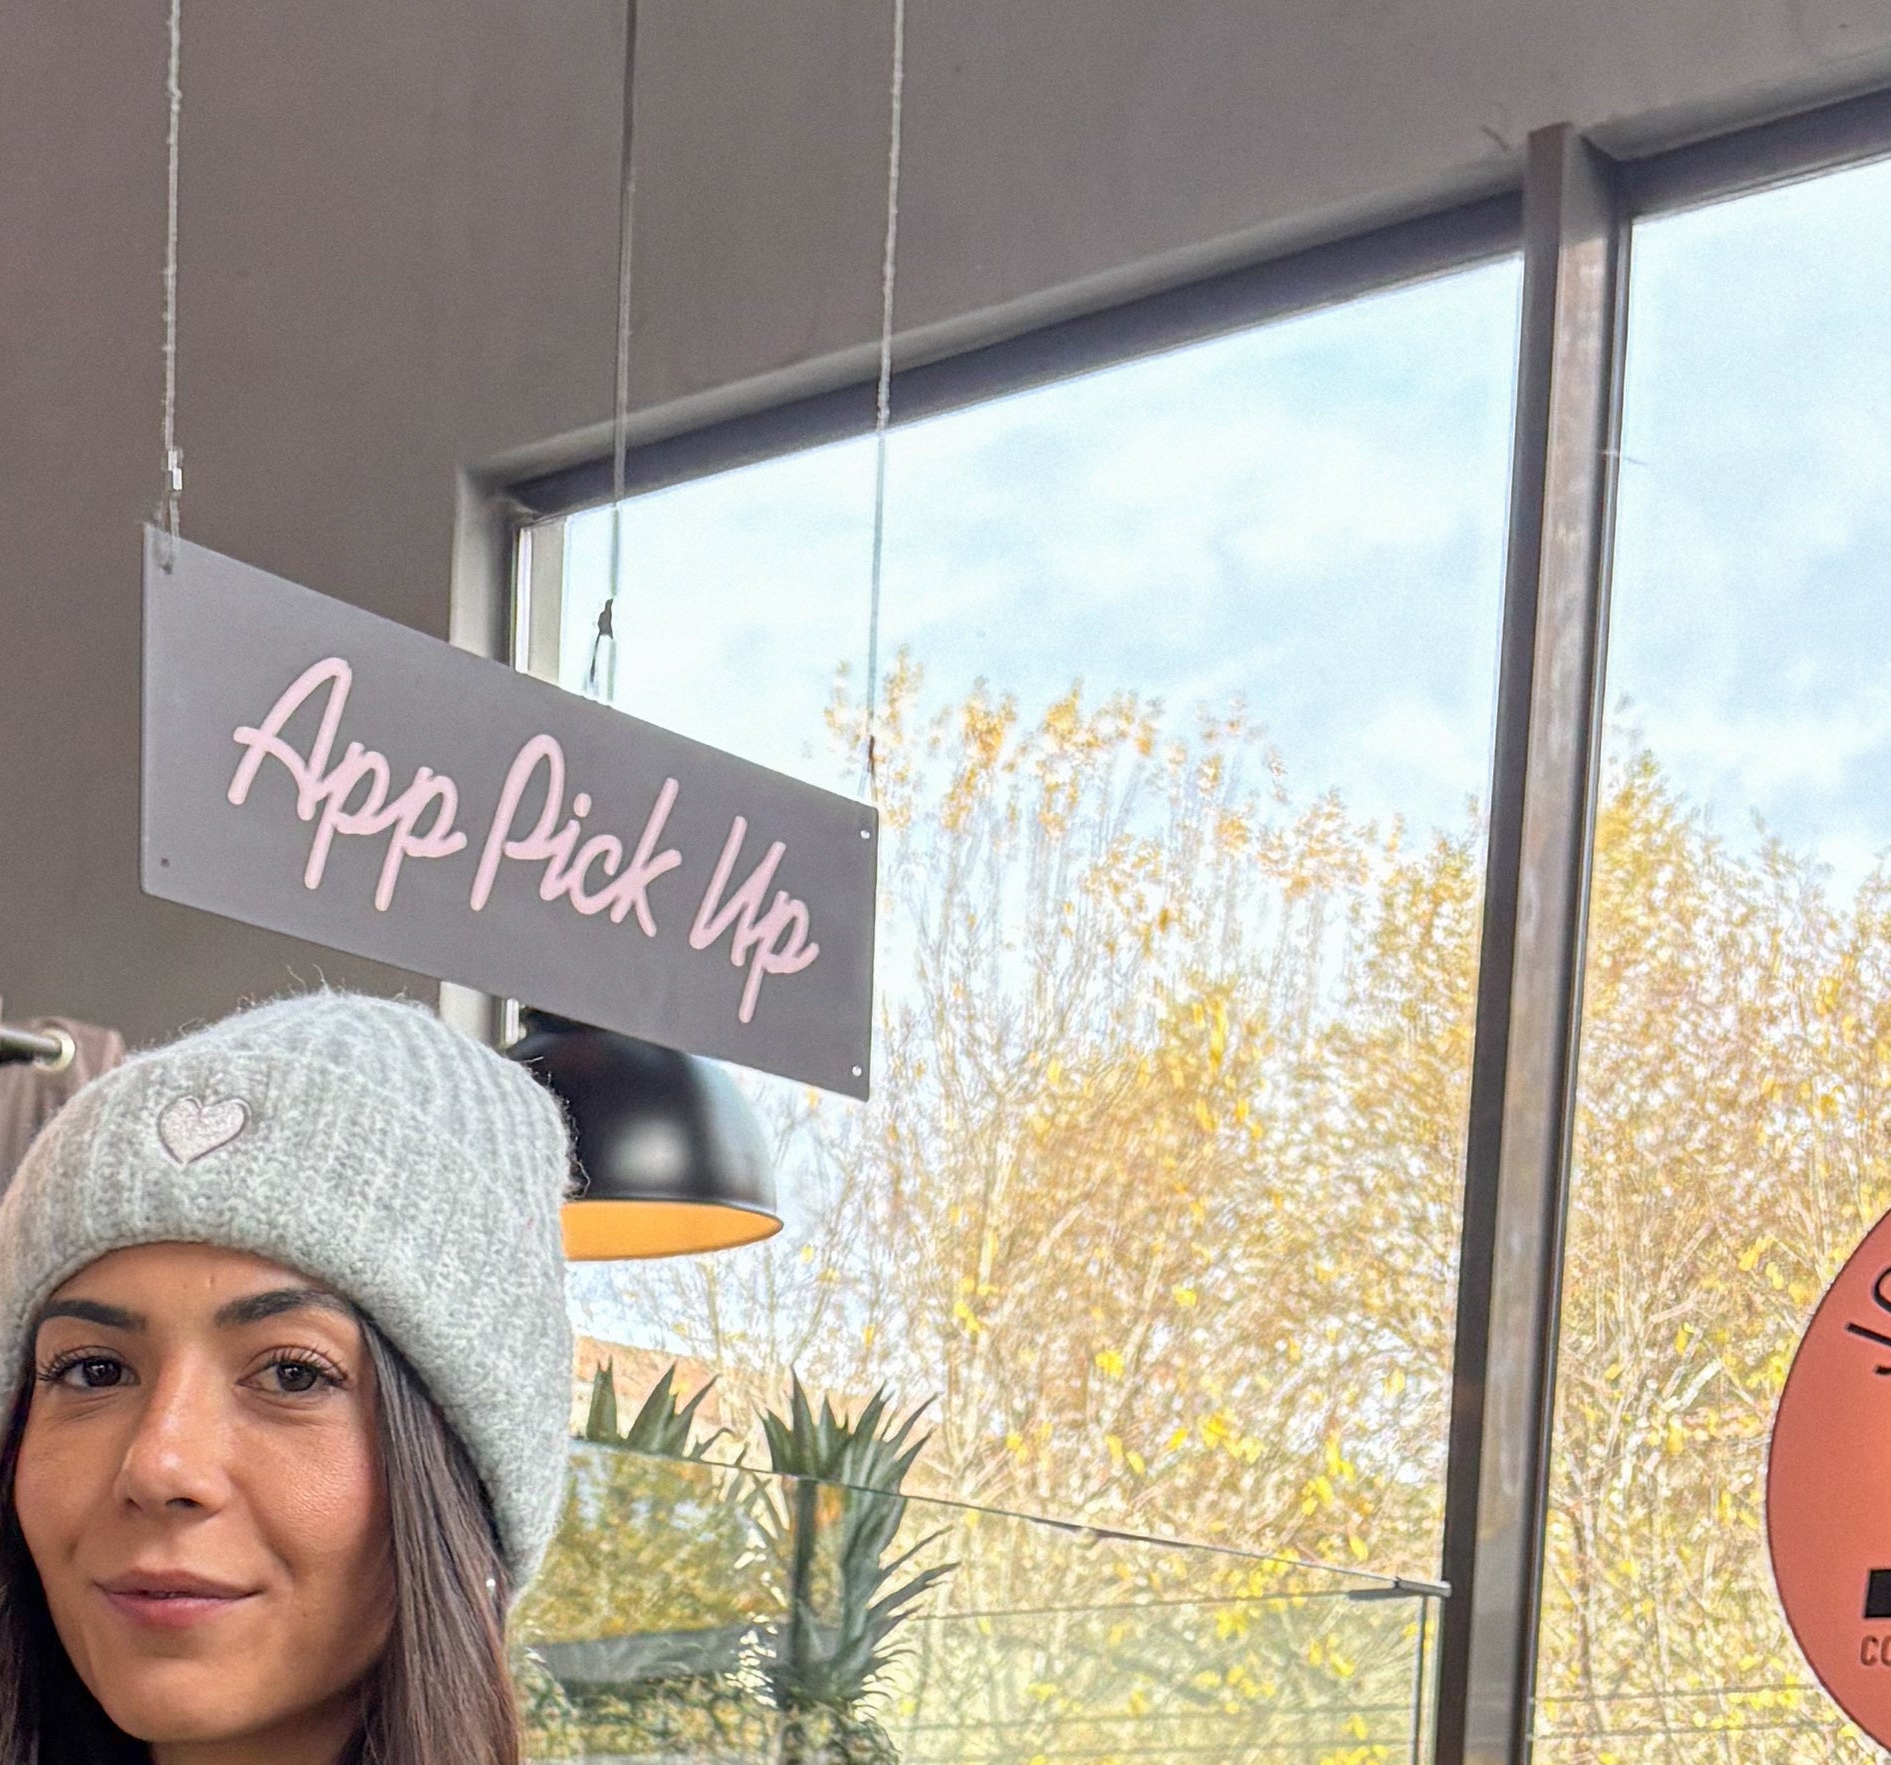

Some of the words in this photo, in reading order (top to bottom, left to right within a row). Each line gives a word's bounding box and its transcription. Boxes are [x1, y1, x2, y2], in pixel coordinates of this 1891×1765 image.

[228, 657, 467, 912] App
[471, 734, 683, 936] Pick
[689, 815, 820, 1024] Up
